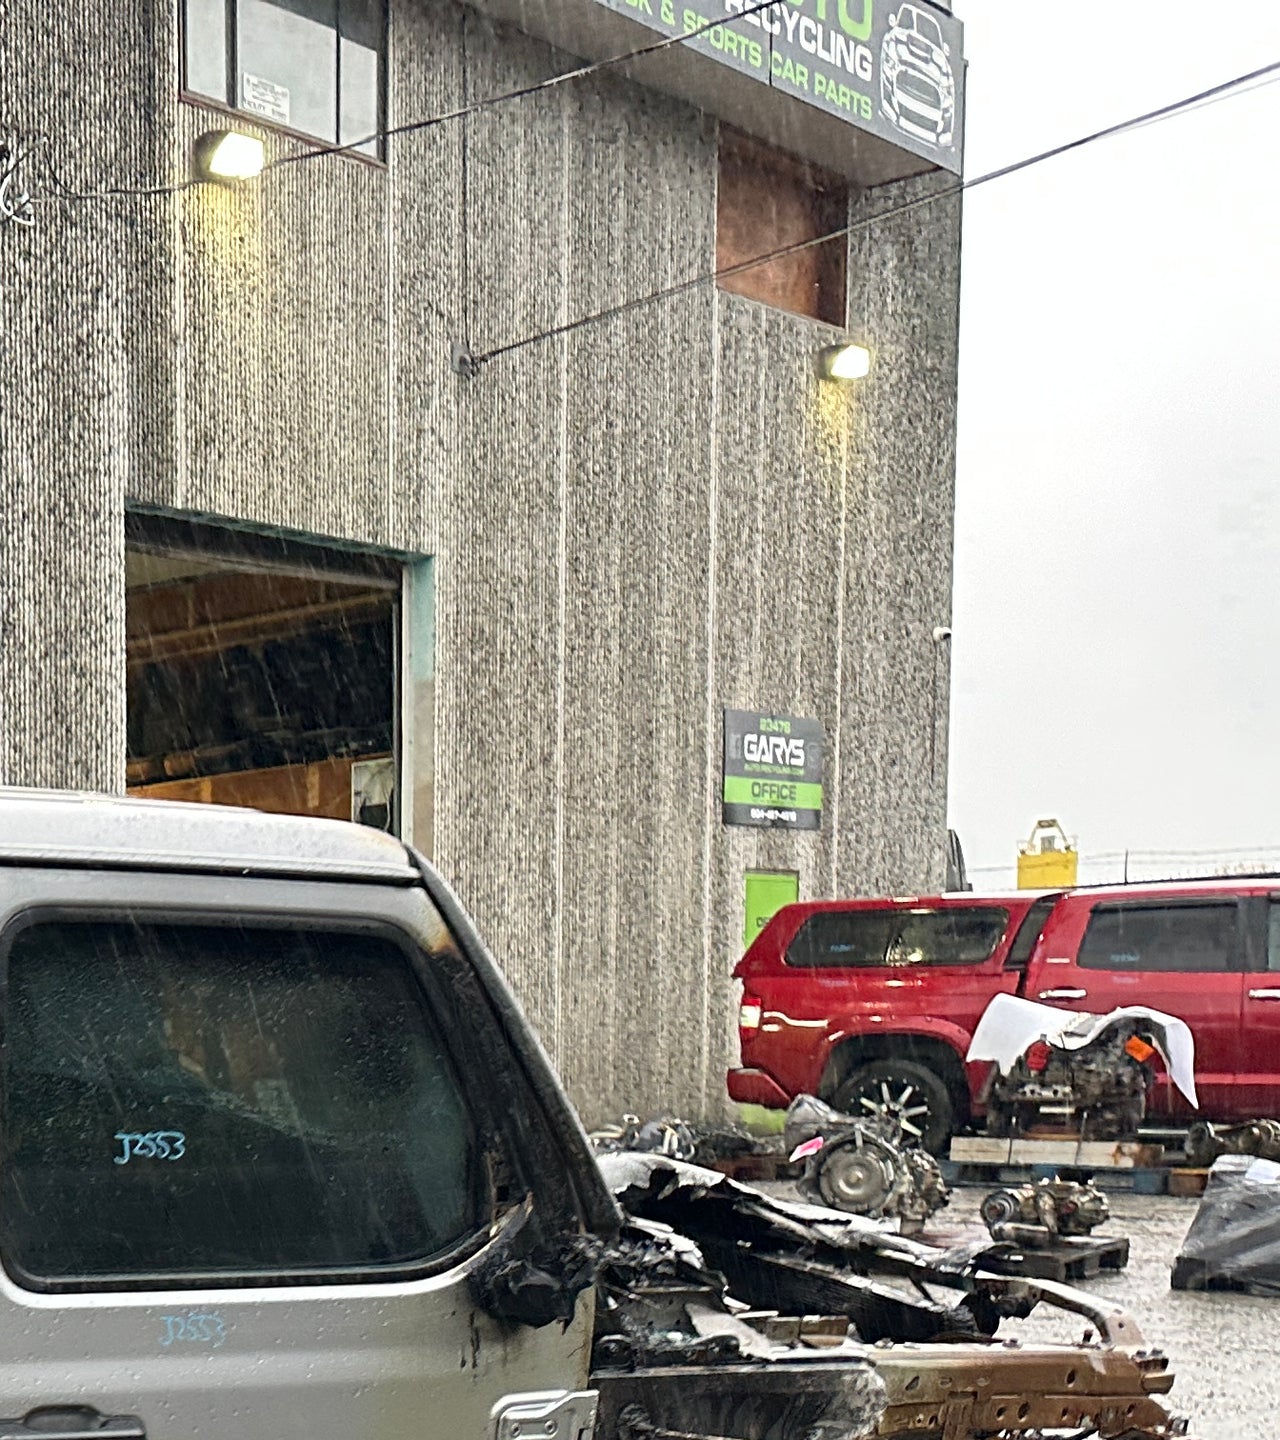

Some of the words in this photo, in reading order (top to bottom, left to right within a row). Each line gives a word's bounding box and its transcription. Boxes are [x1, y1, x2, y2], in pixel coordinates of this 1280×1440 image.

[683, 9, 762, 68] SPORTS
[768, 50, 809, 90] CAR
[815, 72, 872, 120] PARTS
[743, 733, 805, 767] GARYS
[751, 781, 797, 801] OFFICE
[113, 1129, 186, 1165] J2553
[158, 1310, 228, 1348] J2553
